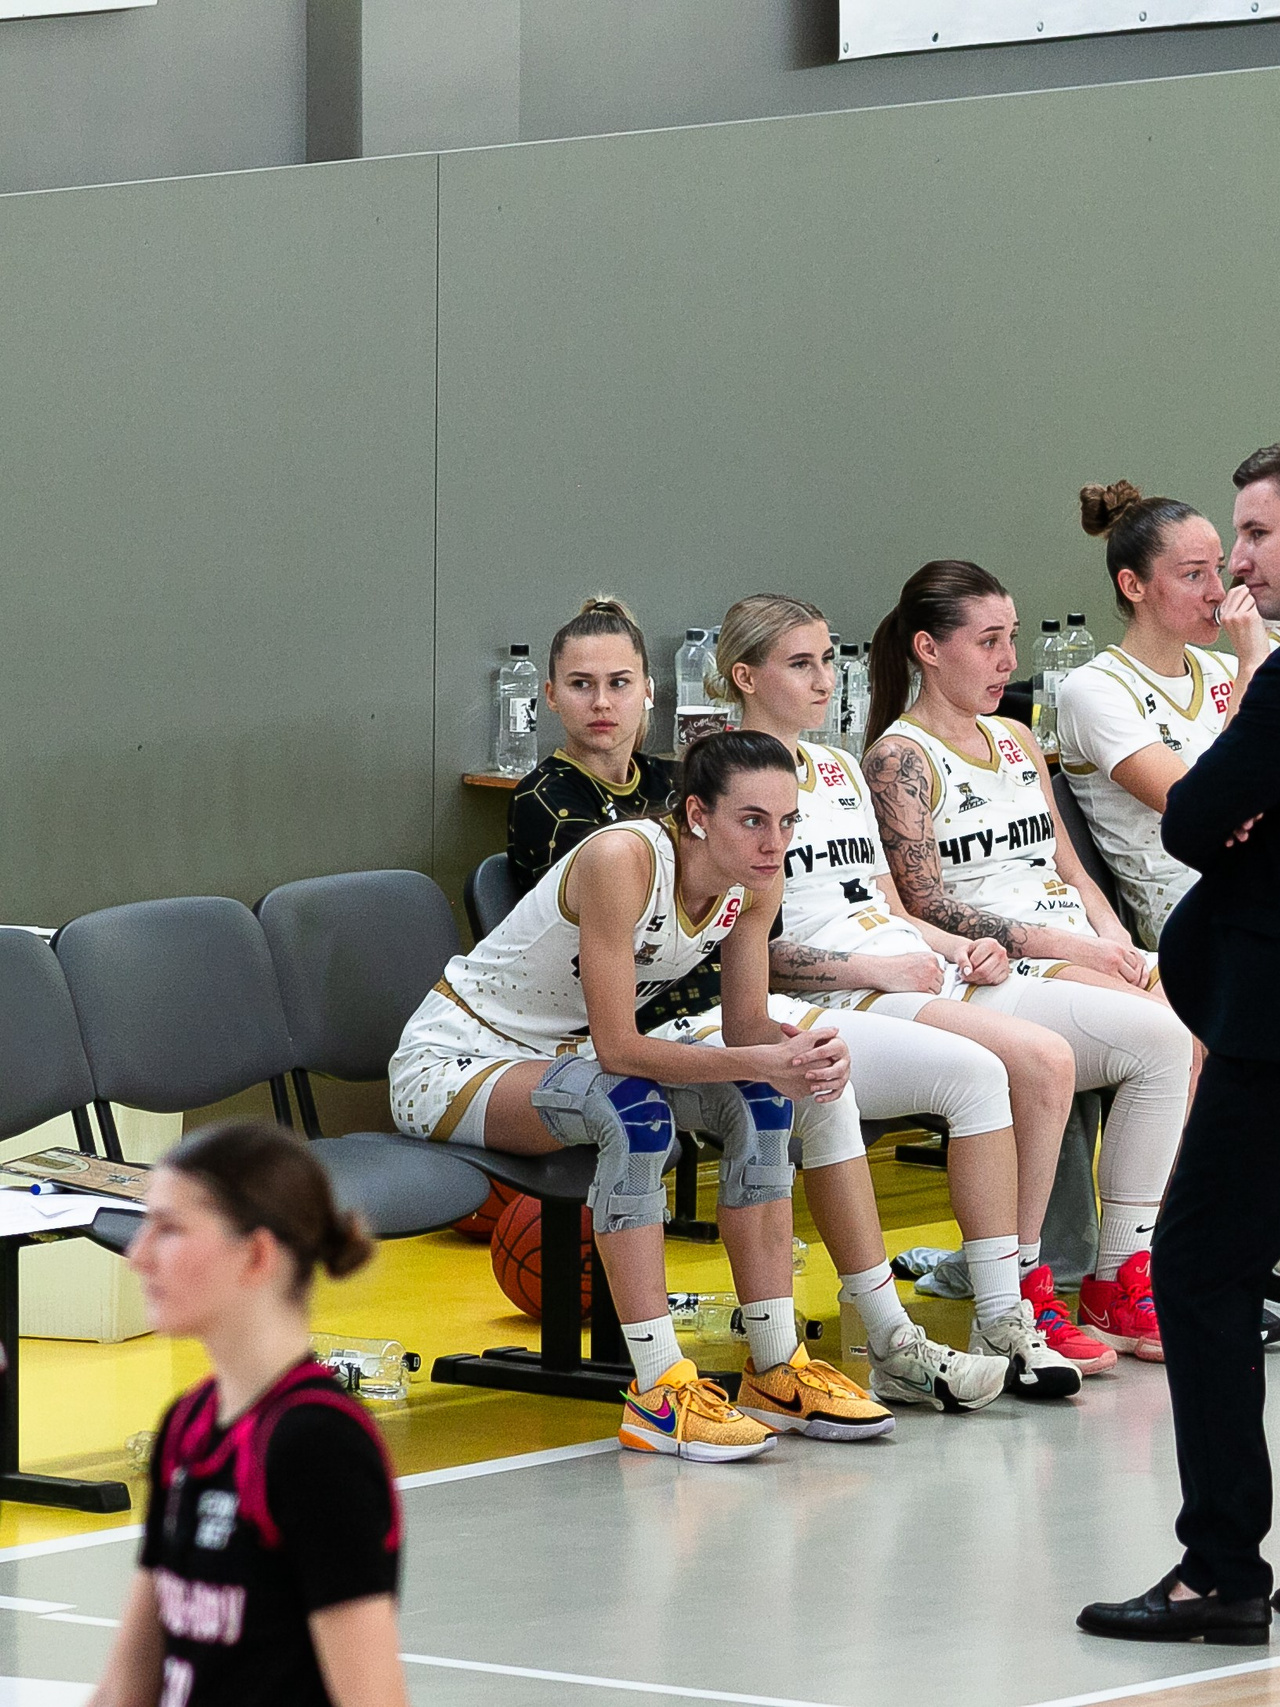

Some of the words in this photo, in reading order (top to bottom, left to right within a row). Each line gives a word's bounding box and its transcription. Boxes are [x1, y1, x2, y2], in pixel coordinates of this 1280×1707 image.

[1210, 681, 1234, 700] FO
[823, 773, 847, 787] BET
[784, 838, 875, 878] ГУ-АТЛАН
